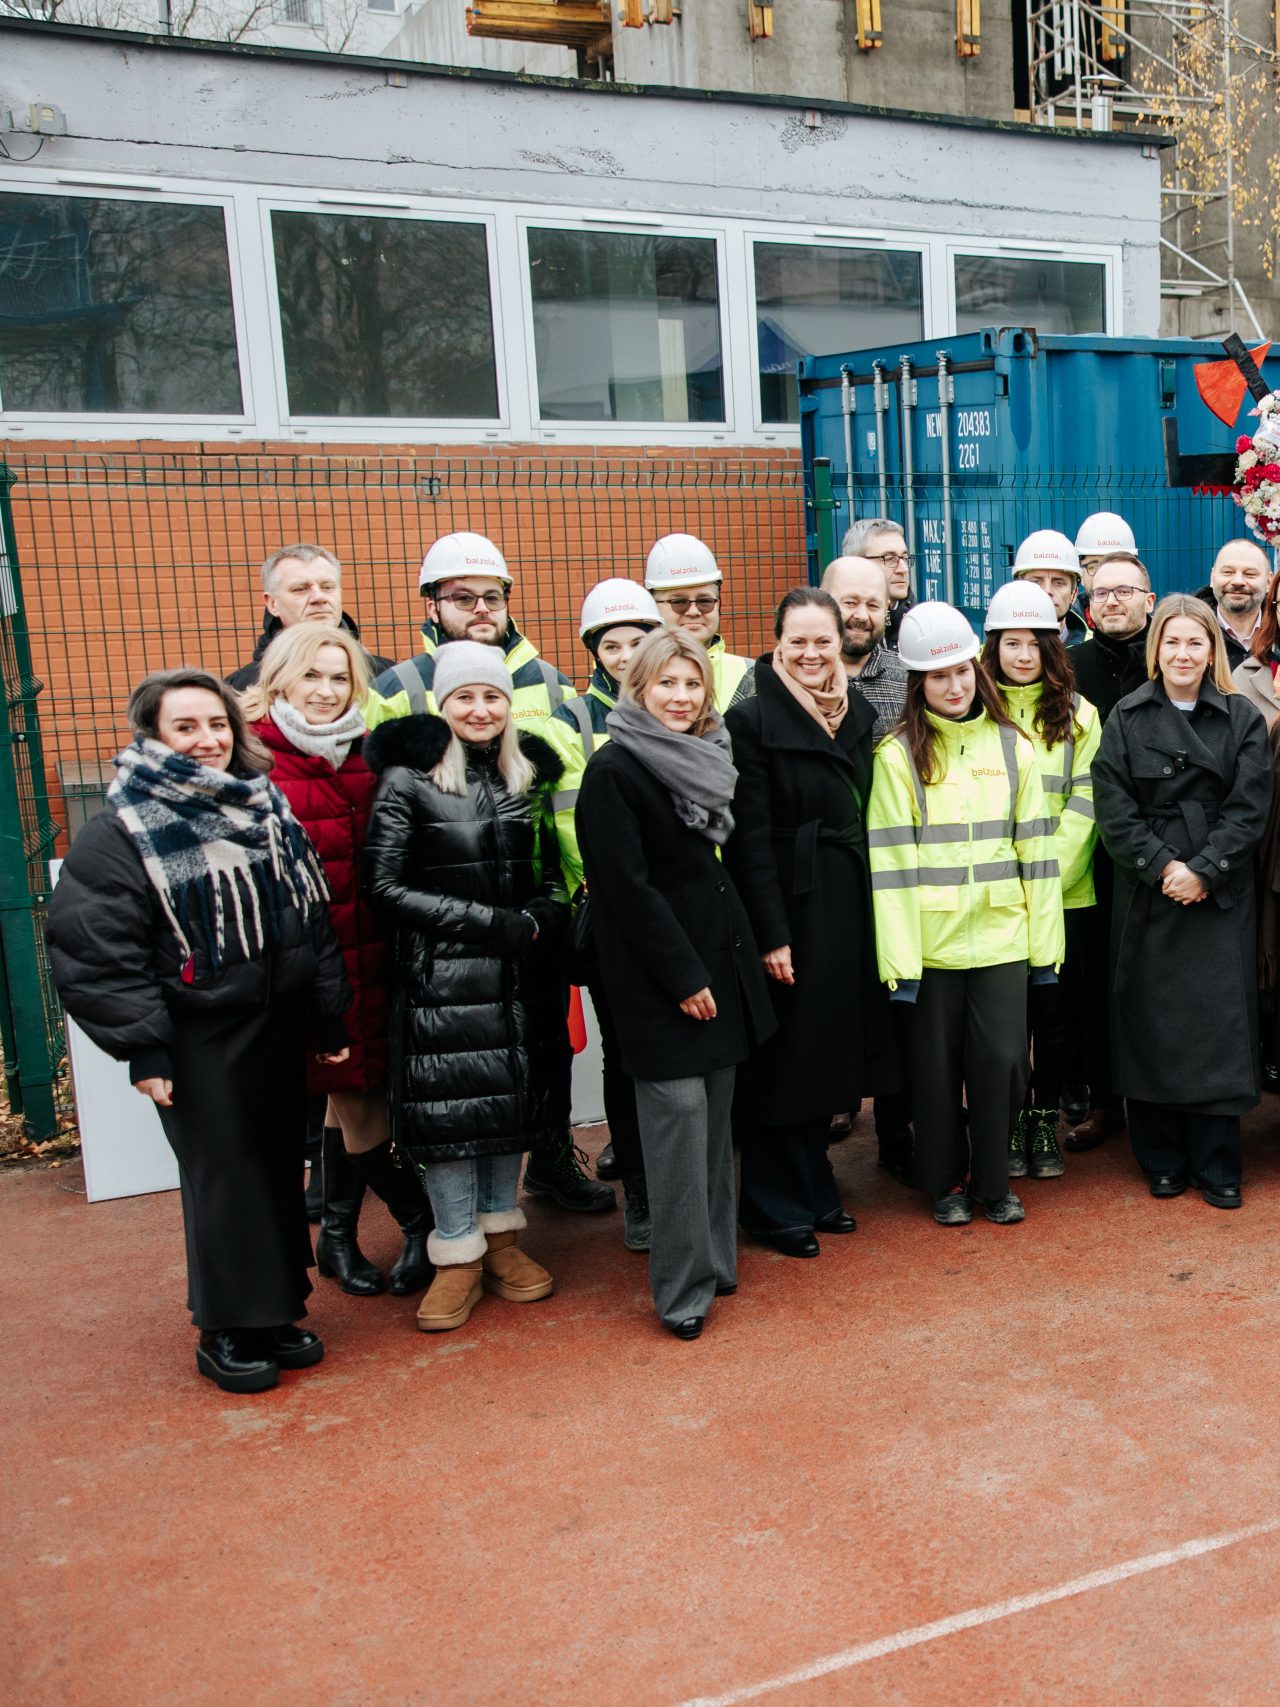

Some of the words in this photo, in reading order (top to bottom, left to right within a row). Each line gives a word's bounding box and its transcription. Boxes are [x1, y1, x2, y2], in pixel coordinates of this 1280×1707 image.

[957, 411, 990, 437] 204383
[958, 443, 980, 468] 22G1
[1097, 539, 1121, 547] balzola
[465, 556, 496, 567] balzola
[1033, 552, 1059, 560] balzola
[671, 567, 698, 576] balzola
[604, 603, 636, 614] balzola
[1012, 610, 1040, 619] balzola
[930, 642, 960, 656] balzola
[511, 708, 545, 720] balzola
